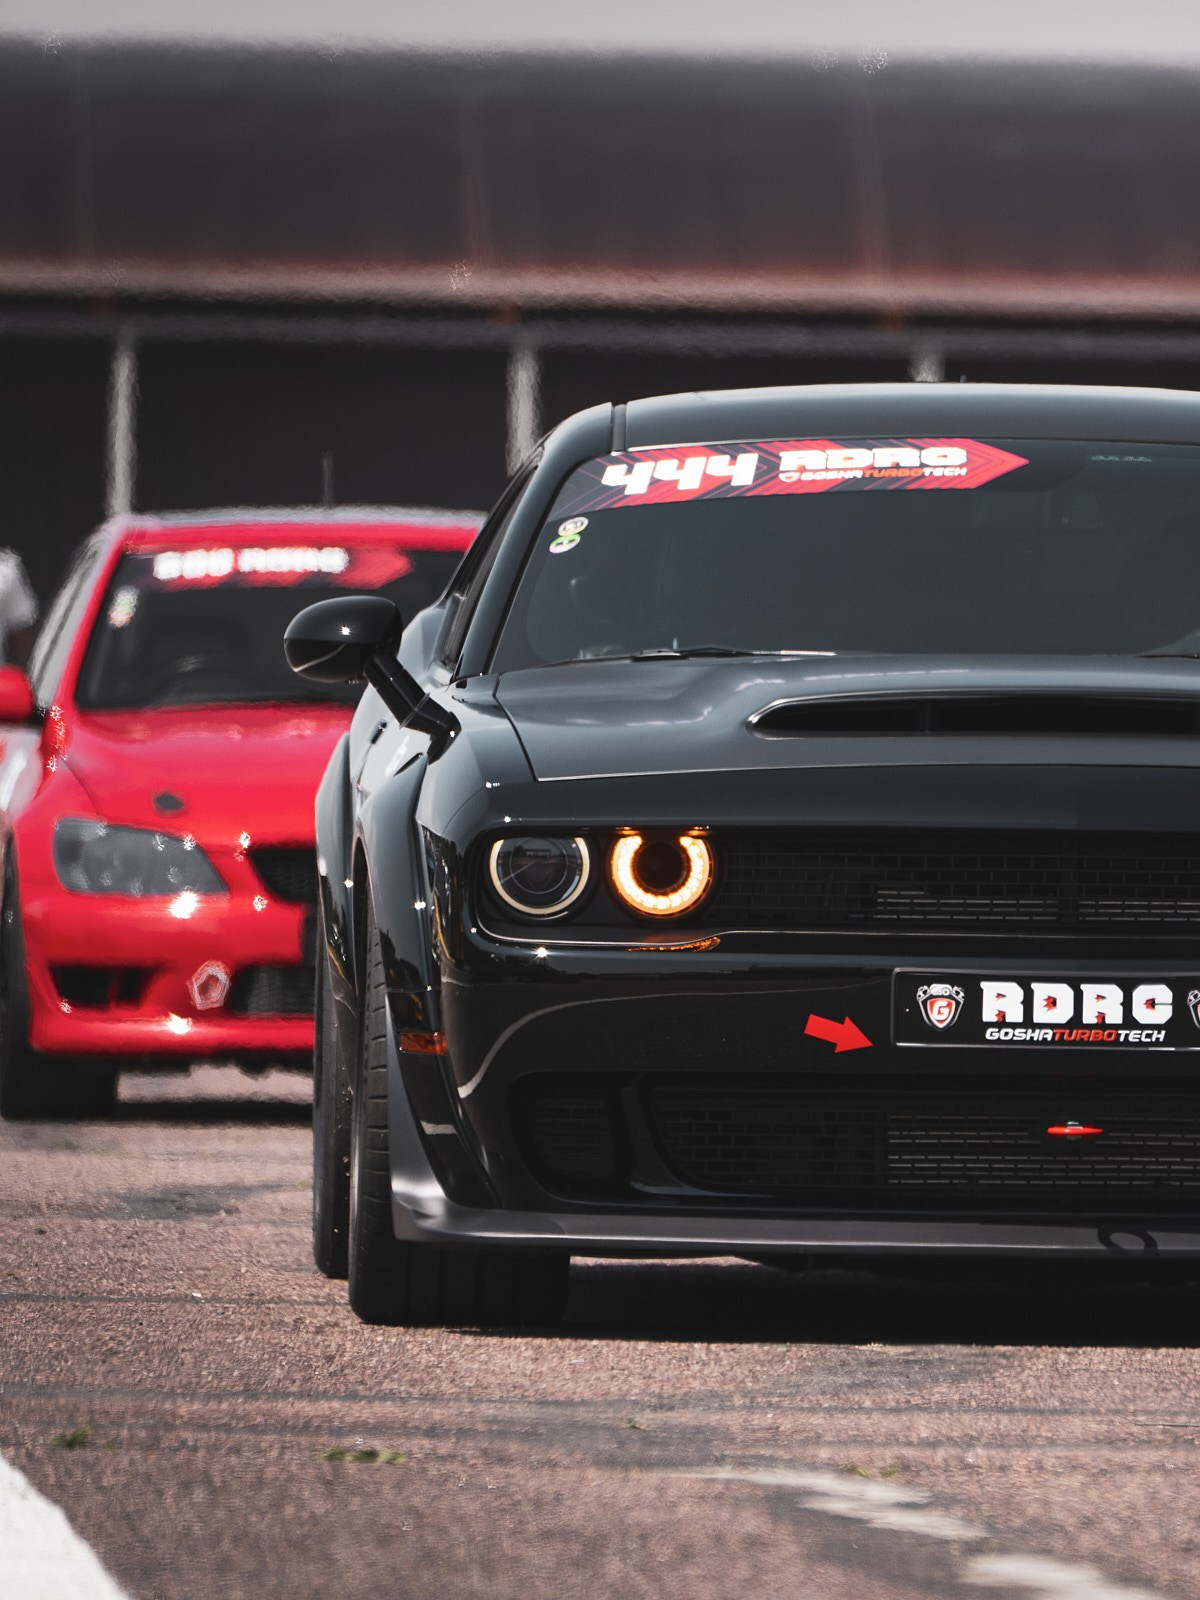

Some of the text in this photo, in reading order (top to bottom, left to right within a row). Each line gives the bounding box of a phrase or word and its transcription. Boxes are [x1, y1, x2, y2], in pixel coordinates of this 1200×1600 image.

[600, 453, 759, 495] 444
[979, 981, 1173, 1025] RDRC
[985, 1027, 1166, 1043] GOSHATURBOTECH
